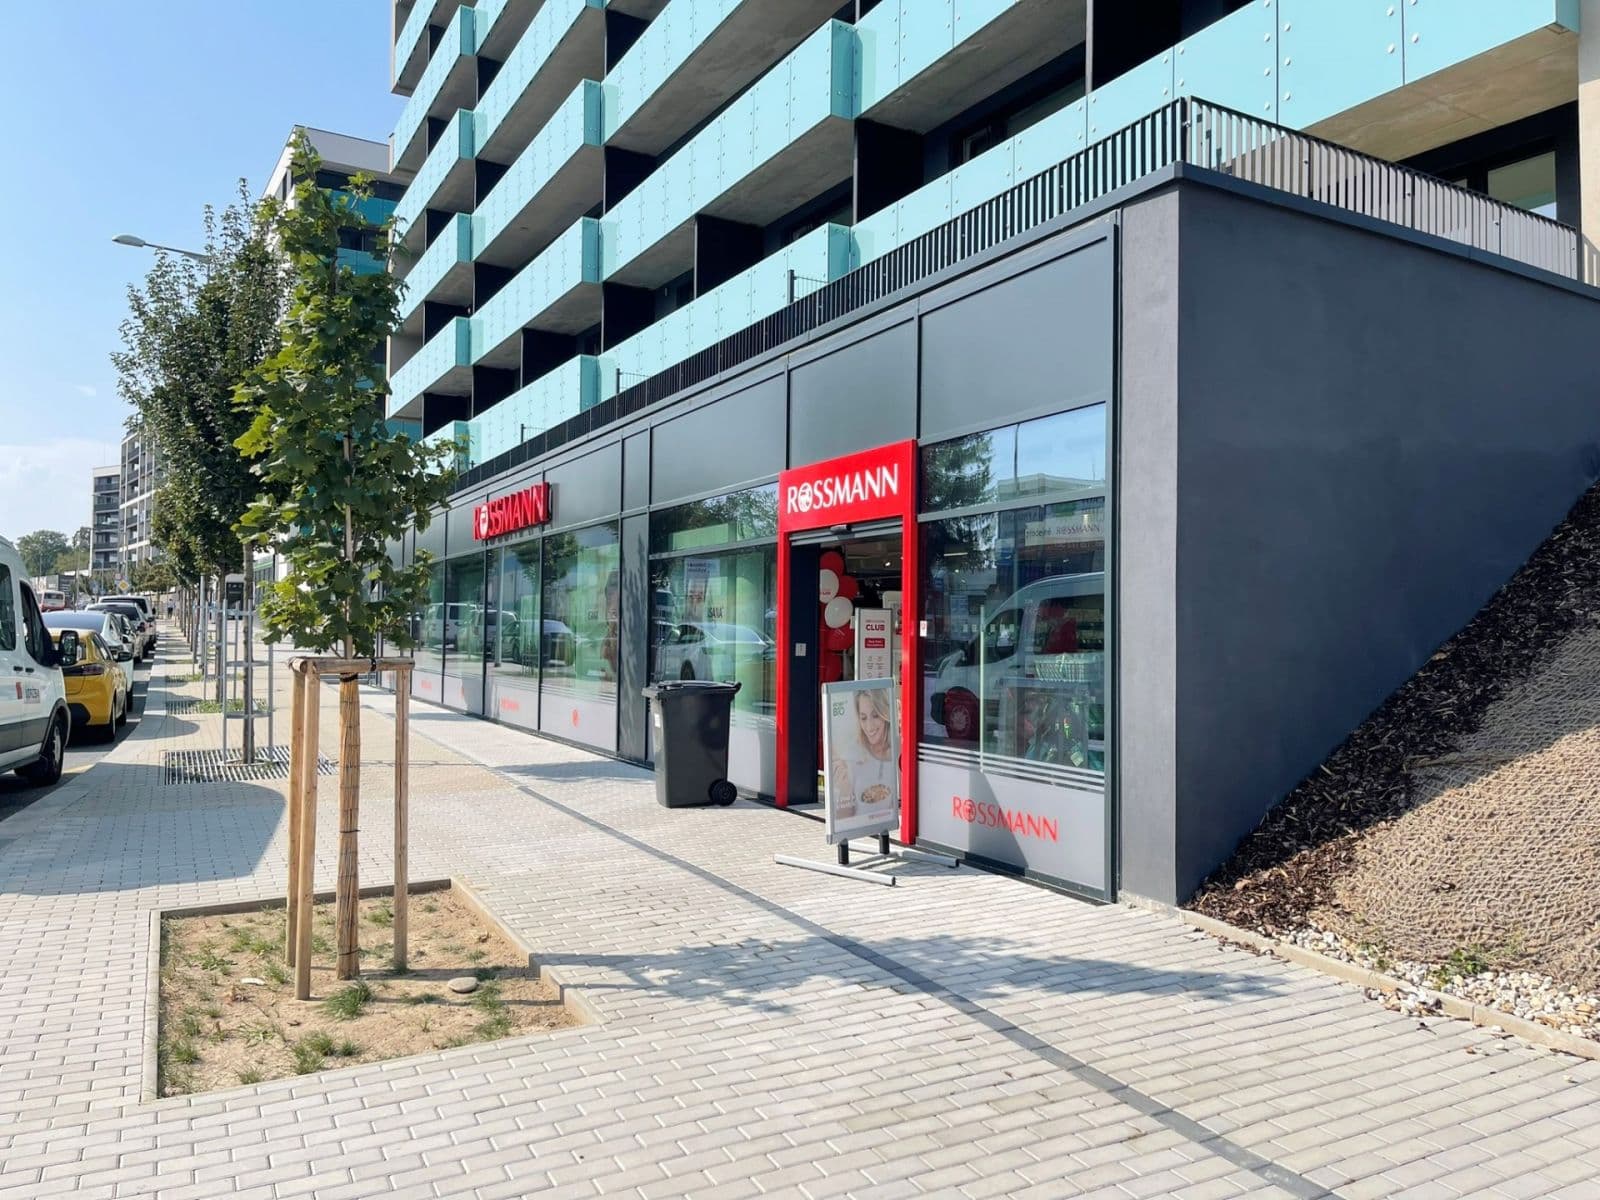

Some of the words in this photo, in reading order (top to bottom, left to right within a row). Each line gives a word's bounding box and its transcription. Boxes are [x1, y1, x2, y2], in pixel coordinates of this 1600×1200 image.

[473, 482, 549, 541] ROSSMANN
[787, 463, 898, 514] ROSSMANN
[952, 796, 1058, 843] ROSSMANN
